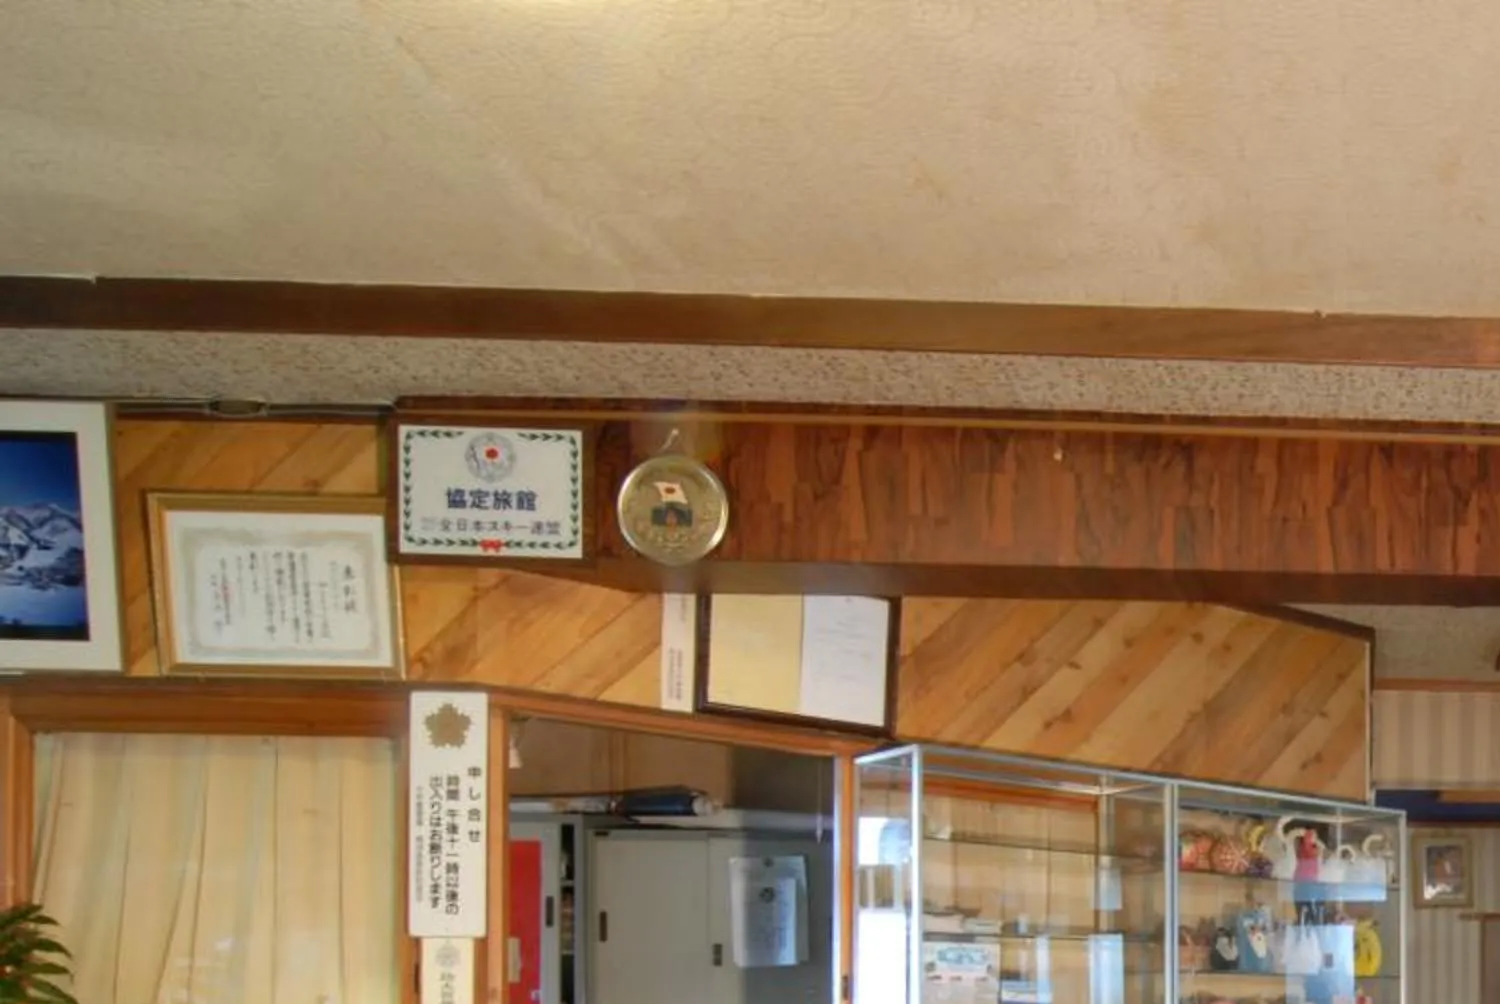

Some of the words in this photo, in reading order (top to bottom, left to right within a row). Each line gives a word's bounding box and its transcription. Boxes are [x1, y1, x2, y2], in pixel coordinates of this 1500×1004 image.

[446, 487, 538, 511] 協定旅館
[467, 766, 482, 843] 申し合せ
